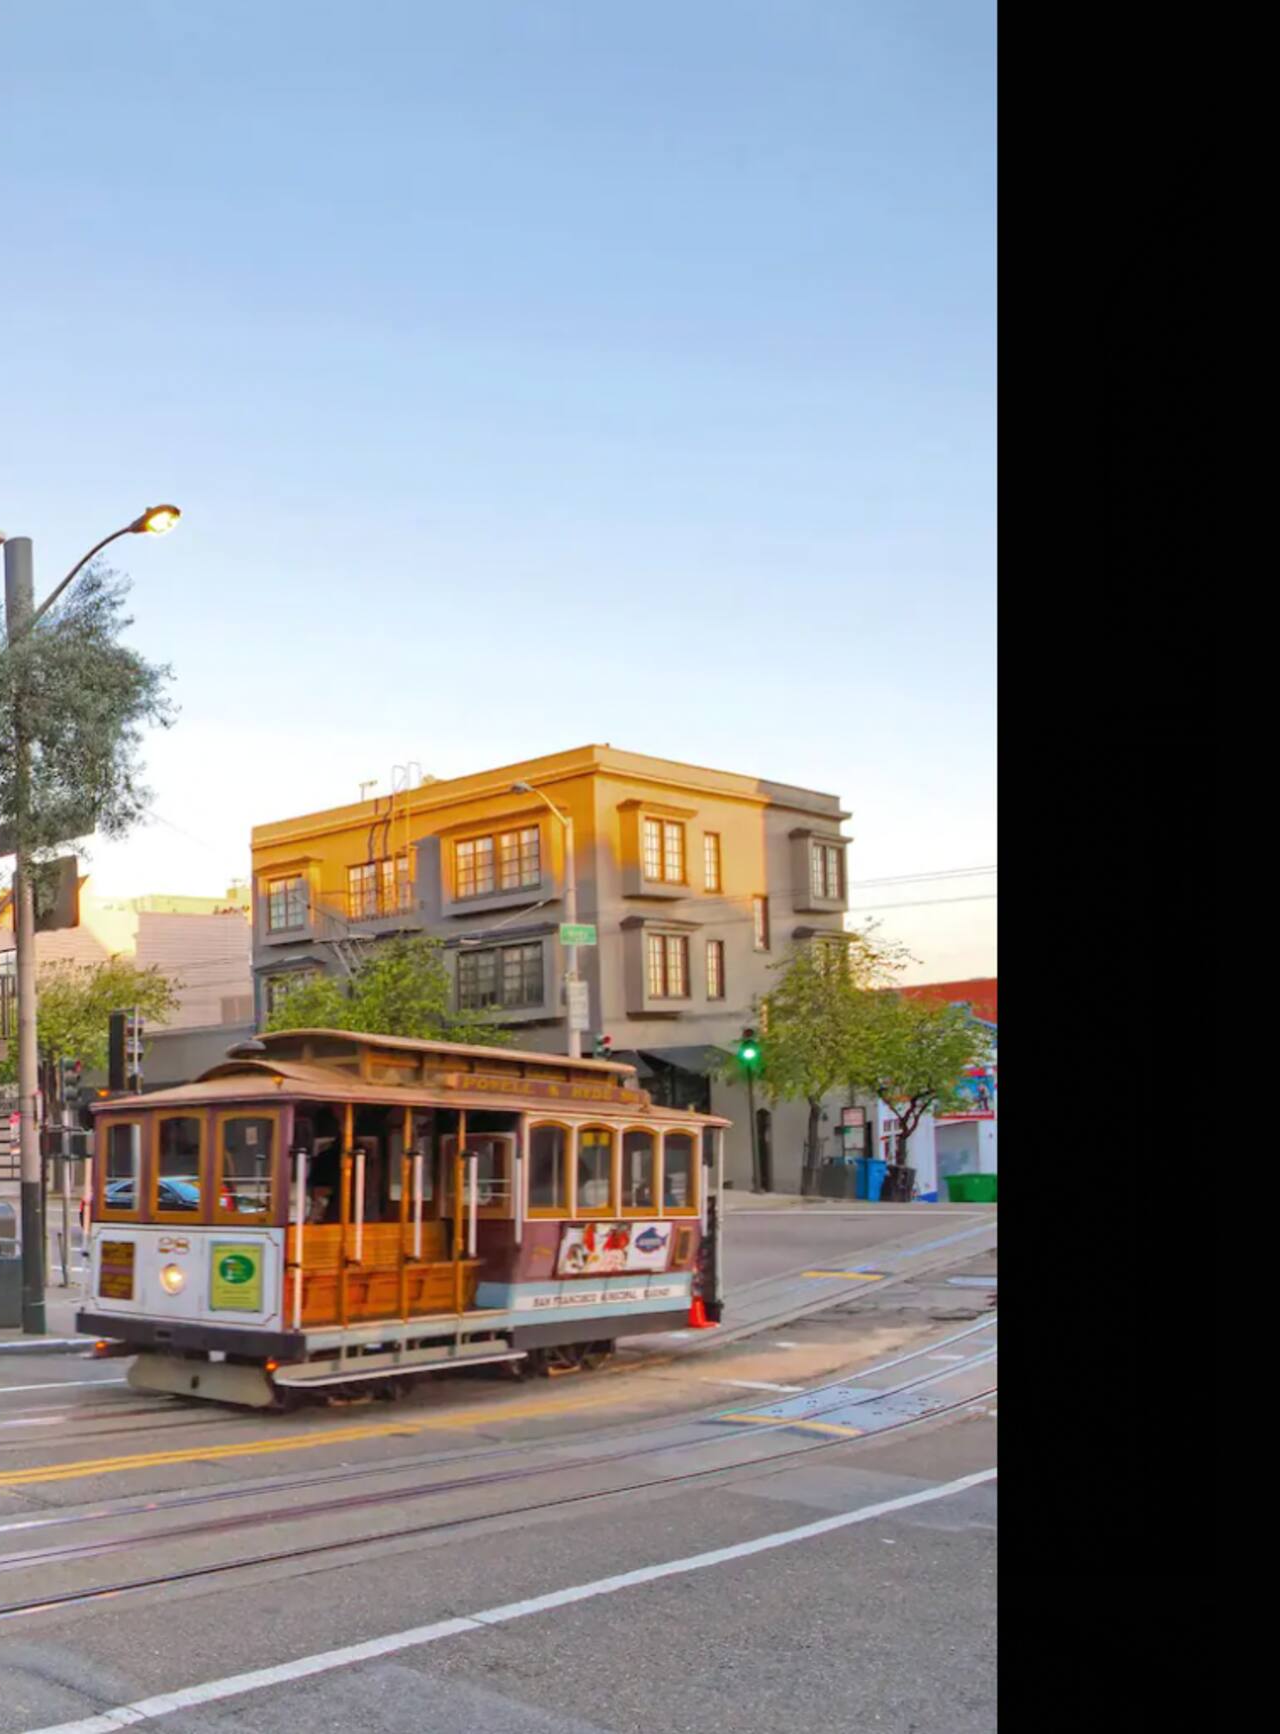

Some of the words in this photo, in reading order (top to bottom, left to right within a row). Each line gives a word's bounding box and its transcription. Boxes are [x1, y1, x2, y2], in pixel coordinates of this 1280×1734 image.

[462, 1074, 533, 1093] POWELL
[533, 1296, 550, 1307] SAN
[553, 1293, 597, 1305] FRANCISCO
